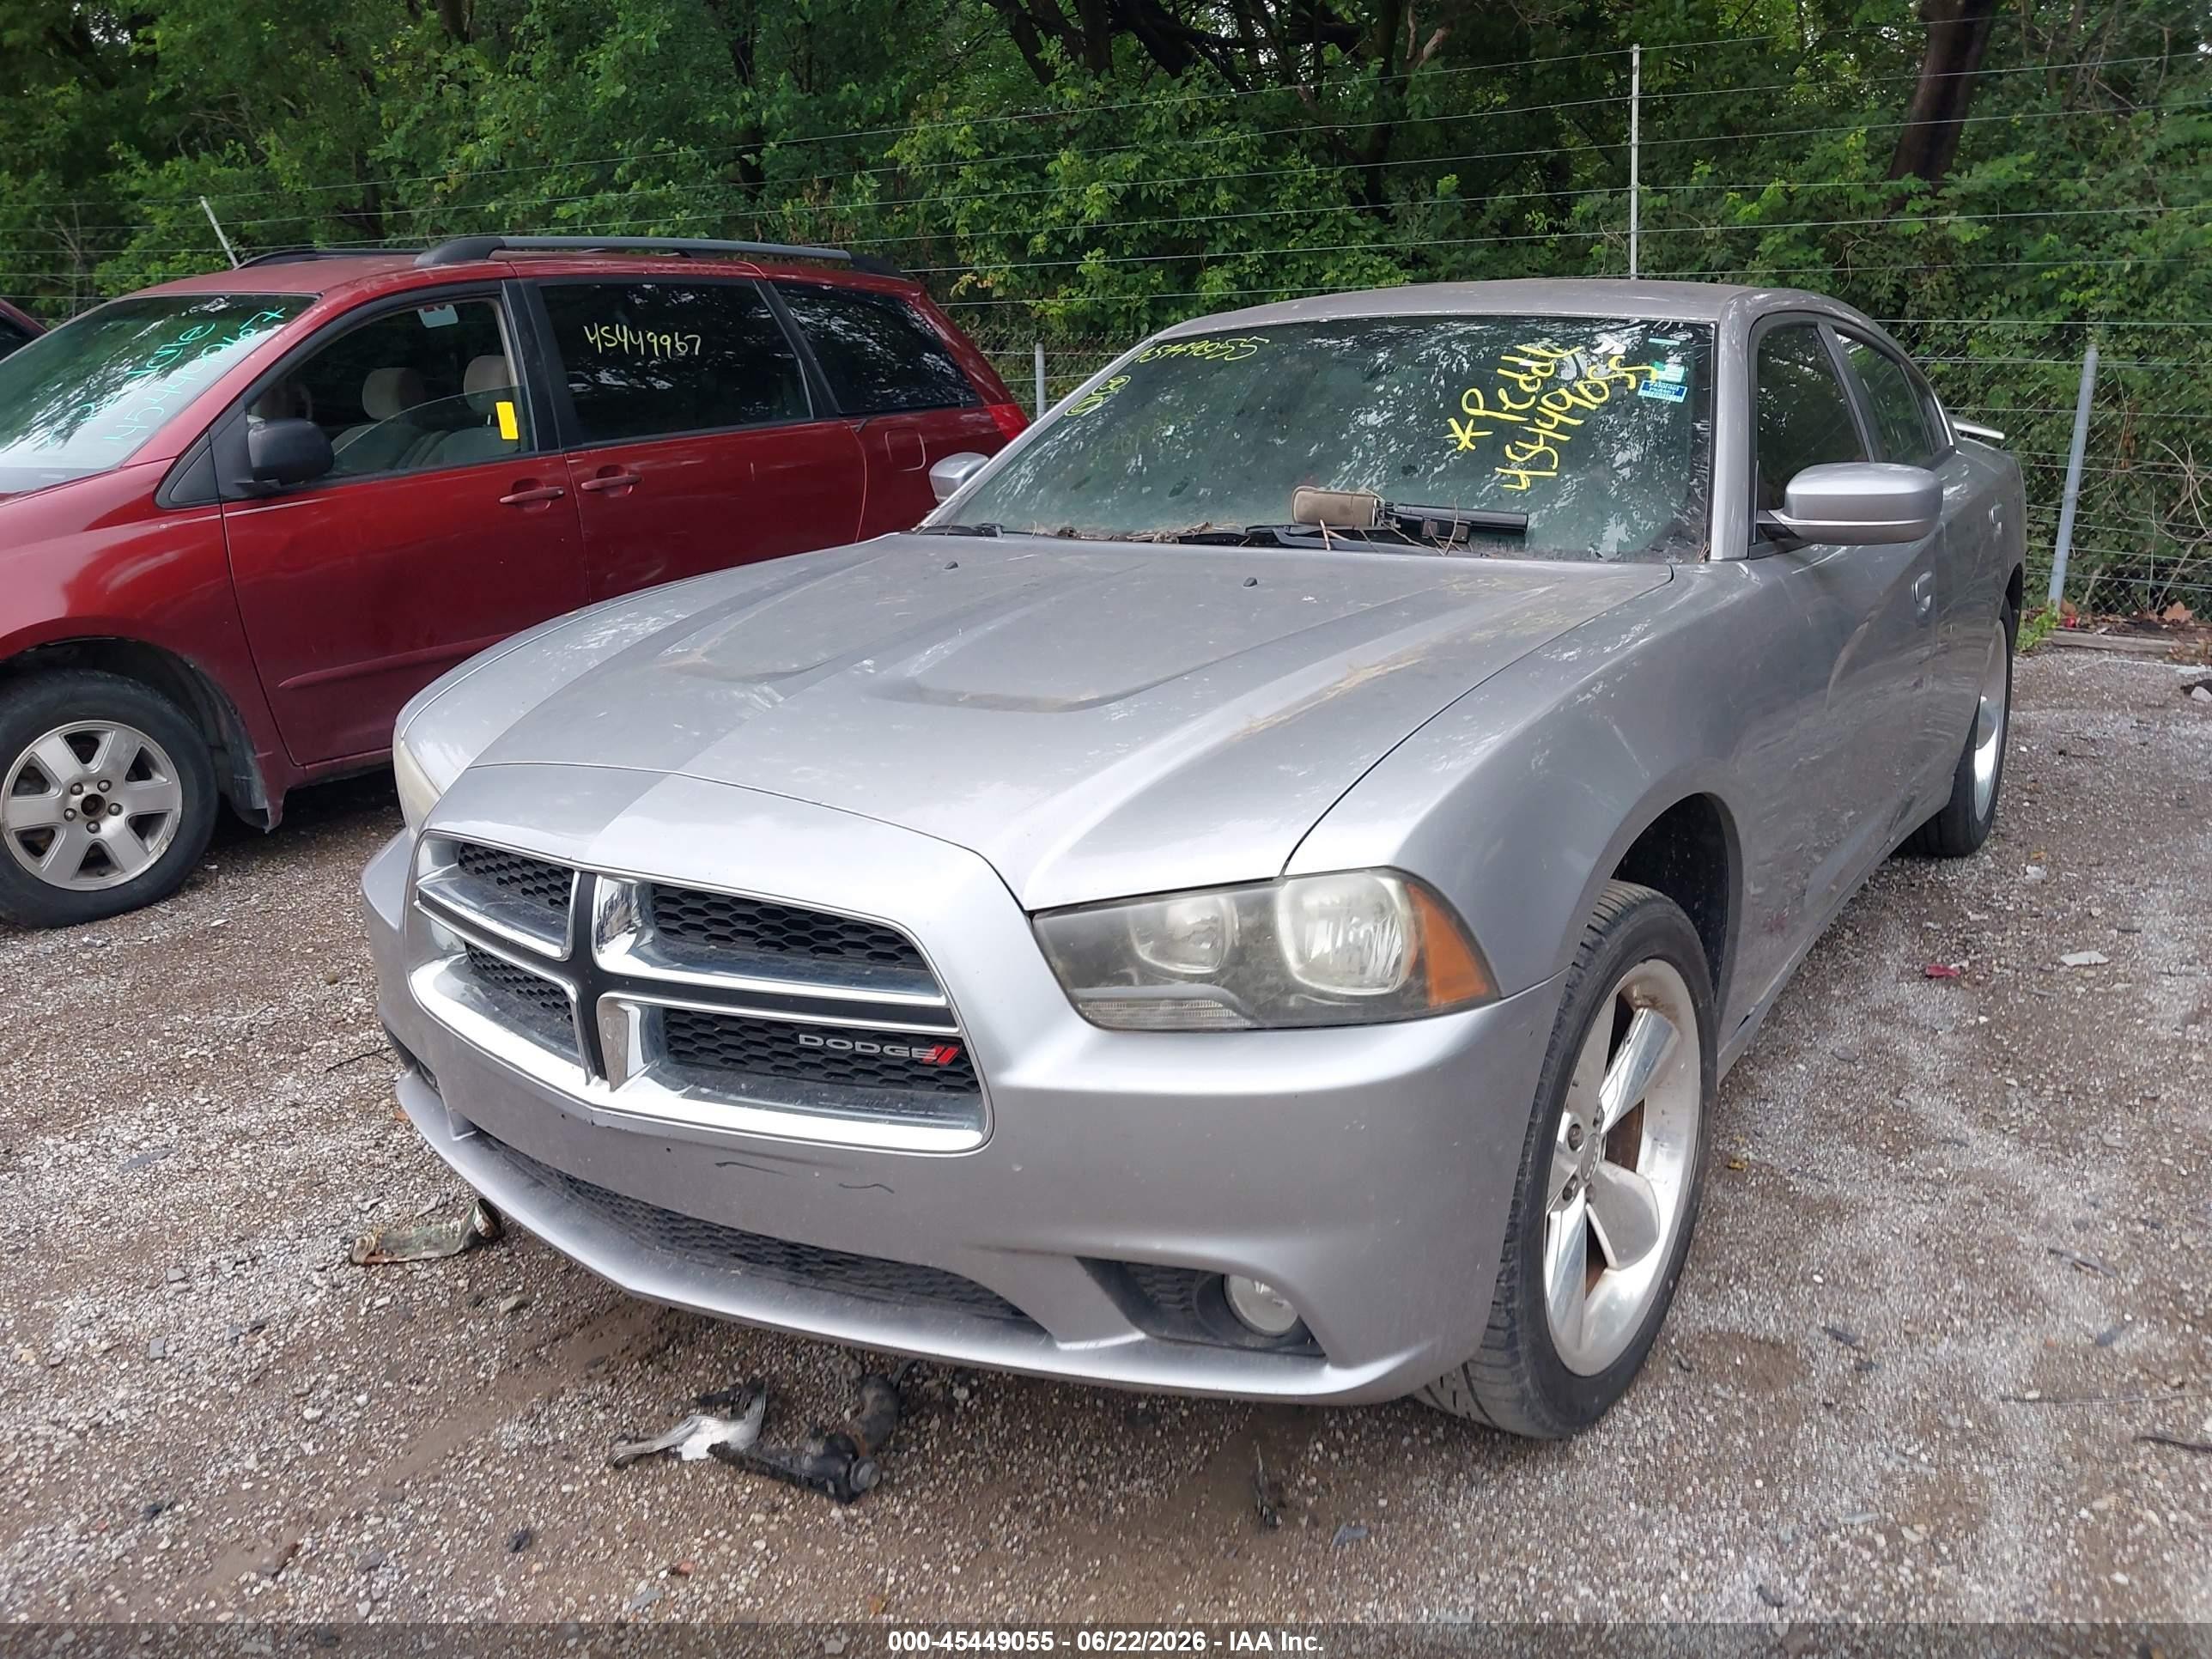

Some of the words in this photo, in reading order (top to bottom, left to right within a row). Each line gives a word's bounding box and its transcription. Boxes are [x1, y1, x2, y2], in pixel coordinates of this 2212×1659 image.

[583, 322, 702, 359] 45449967
[1494, 354, 1658, 490] 45449055
[798, 1033, 938, 1061] DODGE
